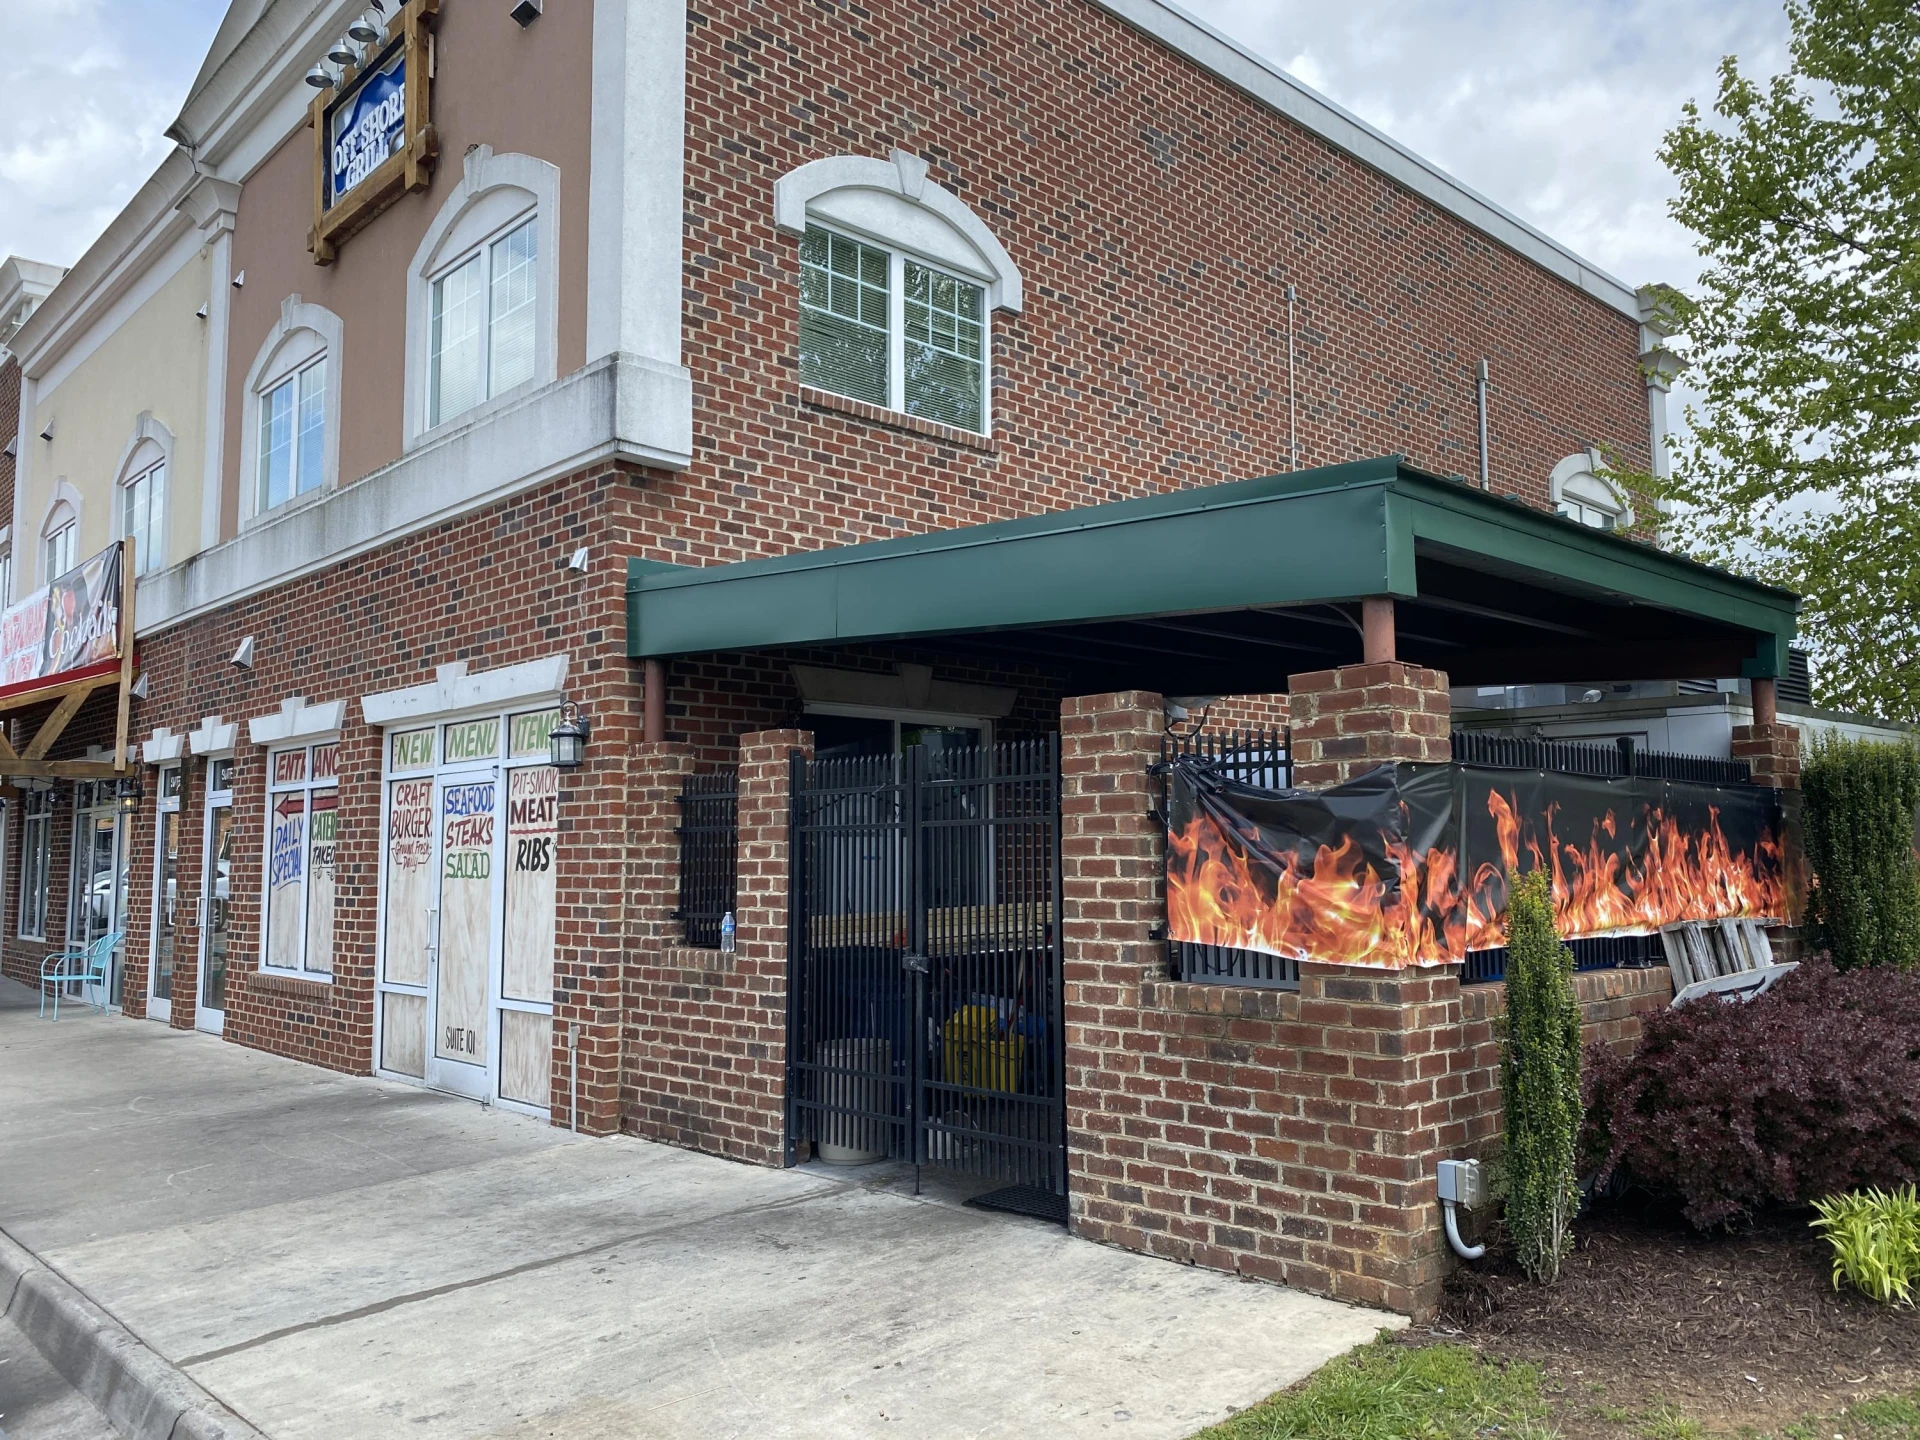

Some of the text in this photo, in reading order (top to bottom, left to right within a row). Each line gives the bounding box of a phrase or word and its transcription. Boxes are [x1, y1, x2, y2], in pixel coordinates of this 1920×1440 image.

[334, 126, 359, 175] OFF
[345, 132, 389, 190] GRILL
[49, 597, 112, 659] Cocktails
[398, 732, 434, 766] NEW
[449, 721, 499, 758] MENU
[396, 783, 432, 806] CRAFT
[446, 784, 495, 816] SEAFOOD
[510, 796, 558, 826] MEAT
[275, 816, 303, 854] DAILY
[312, 811, 337, 841] CATER
[391, 806, 432, 841] BURGER
[446, 816, 494, 849] STEAKS
[444, 851, 491, 880] SALAD
[515, 836, 551, 872] RIBS
[445, 1025, 475, 1055] SUITE 101
